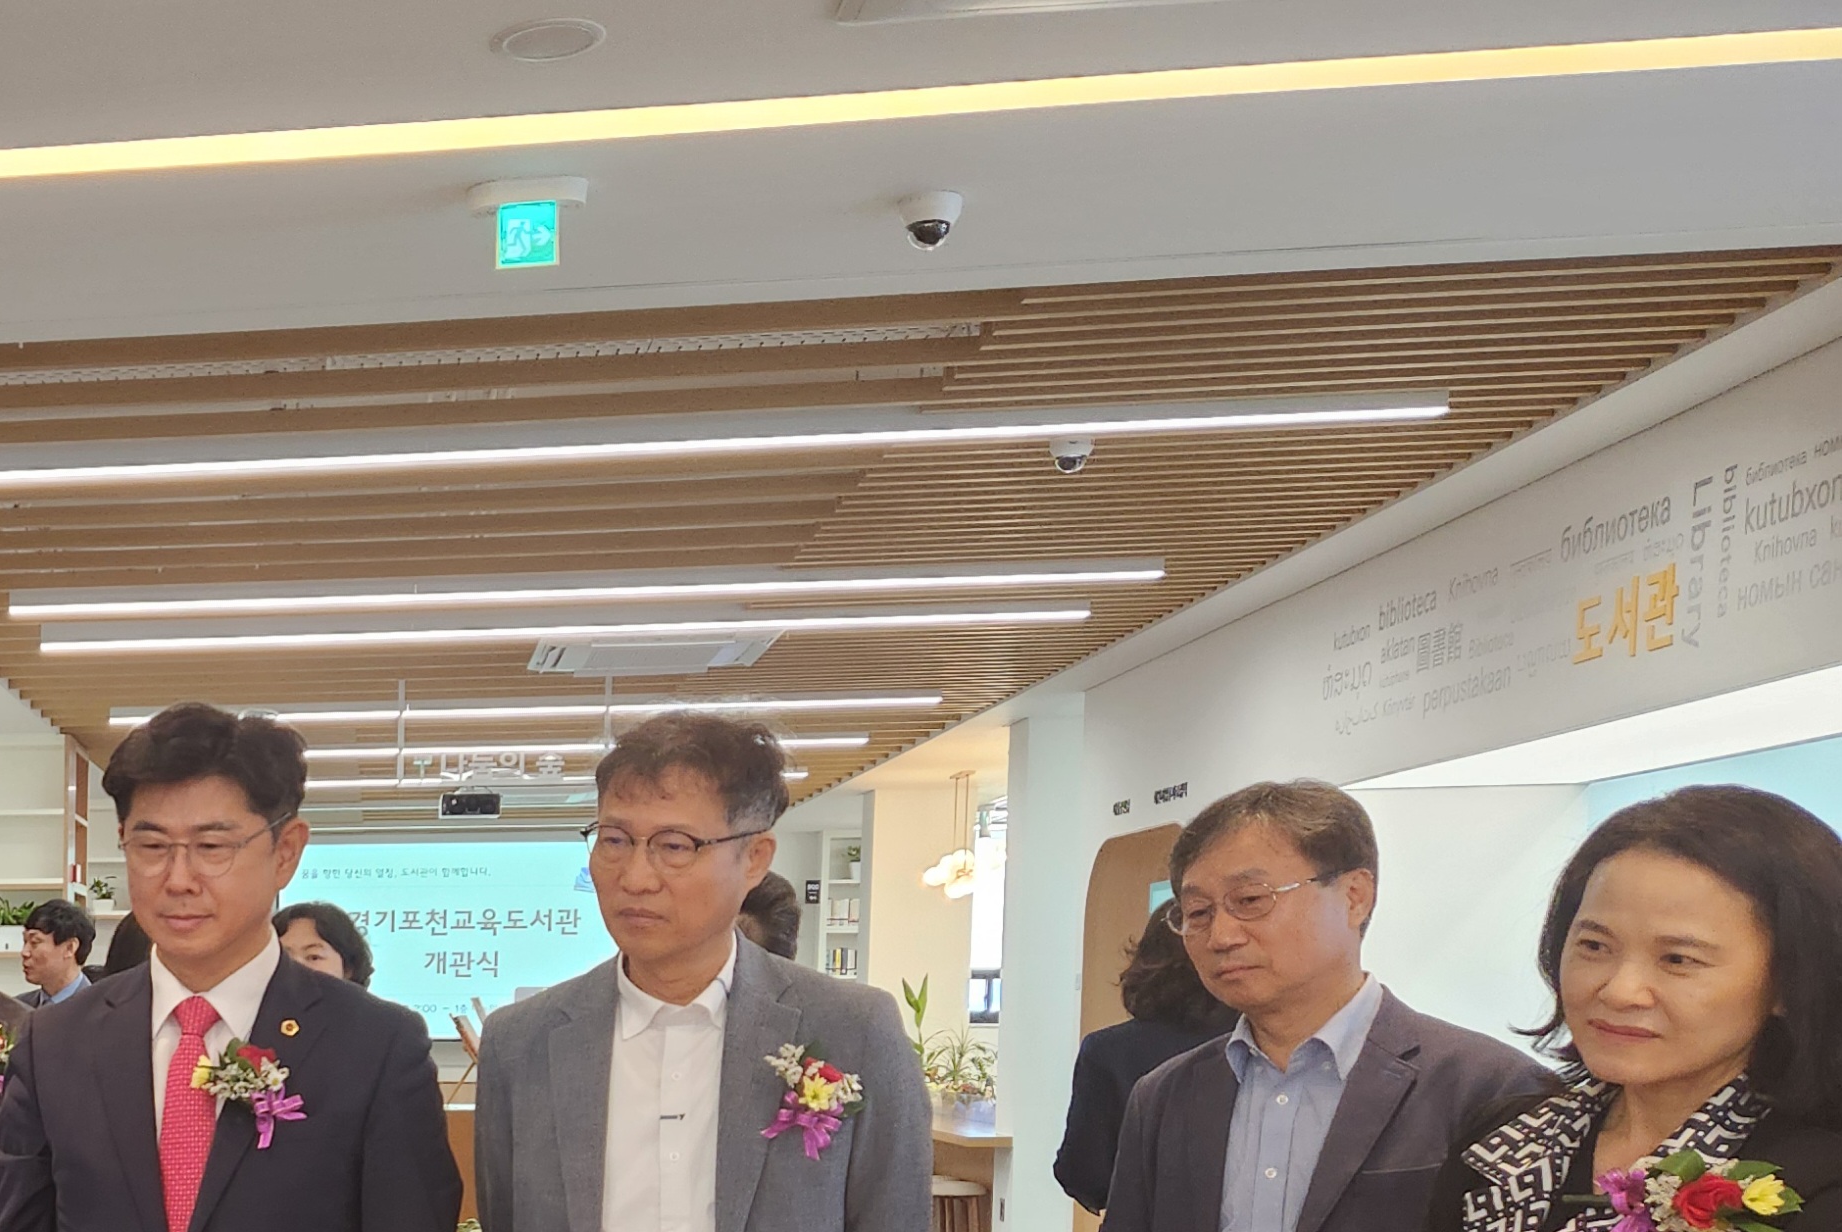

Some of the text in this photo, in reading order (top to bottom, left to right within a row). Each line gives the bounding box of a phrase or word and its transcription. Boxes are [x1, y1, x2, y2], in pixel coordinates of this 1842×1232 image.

[1560, 496, 1672, 563] библиотека
[1681, 475, 1714, 648] Library
[1378, 590, 1437, 631] biblioteca
[1572, 562, 1680, 666] 도서관
[1423, 665, 1511, 720] perpustakaan
[344, 867, 372, 879] 당신의
[400, 867, 438, 878] 도서관이
[441, 866, 492, 878] 함께합니다.
[350, 907, 582, 938] 경기포천교육도서관
[424, 950, 500, 978] 개관식
